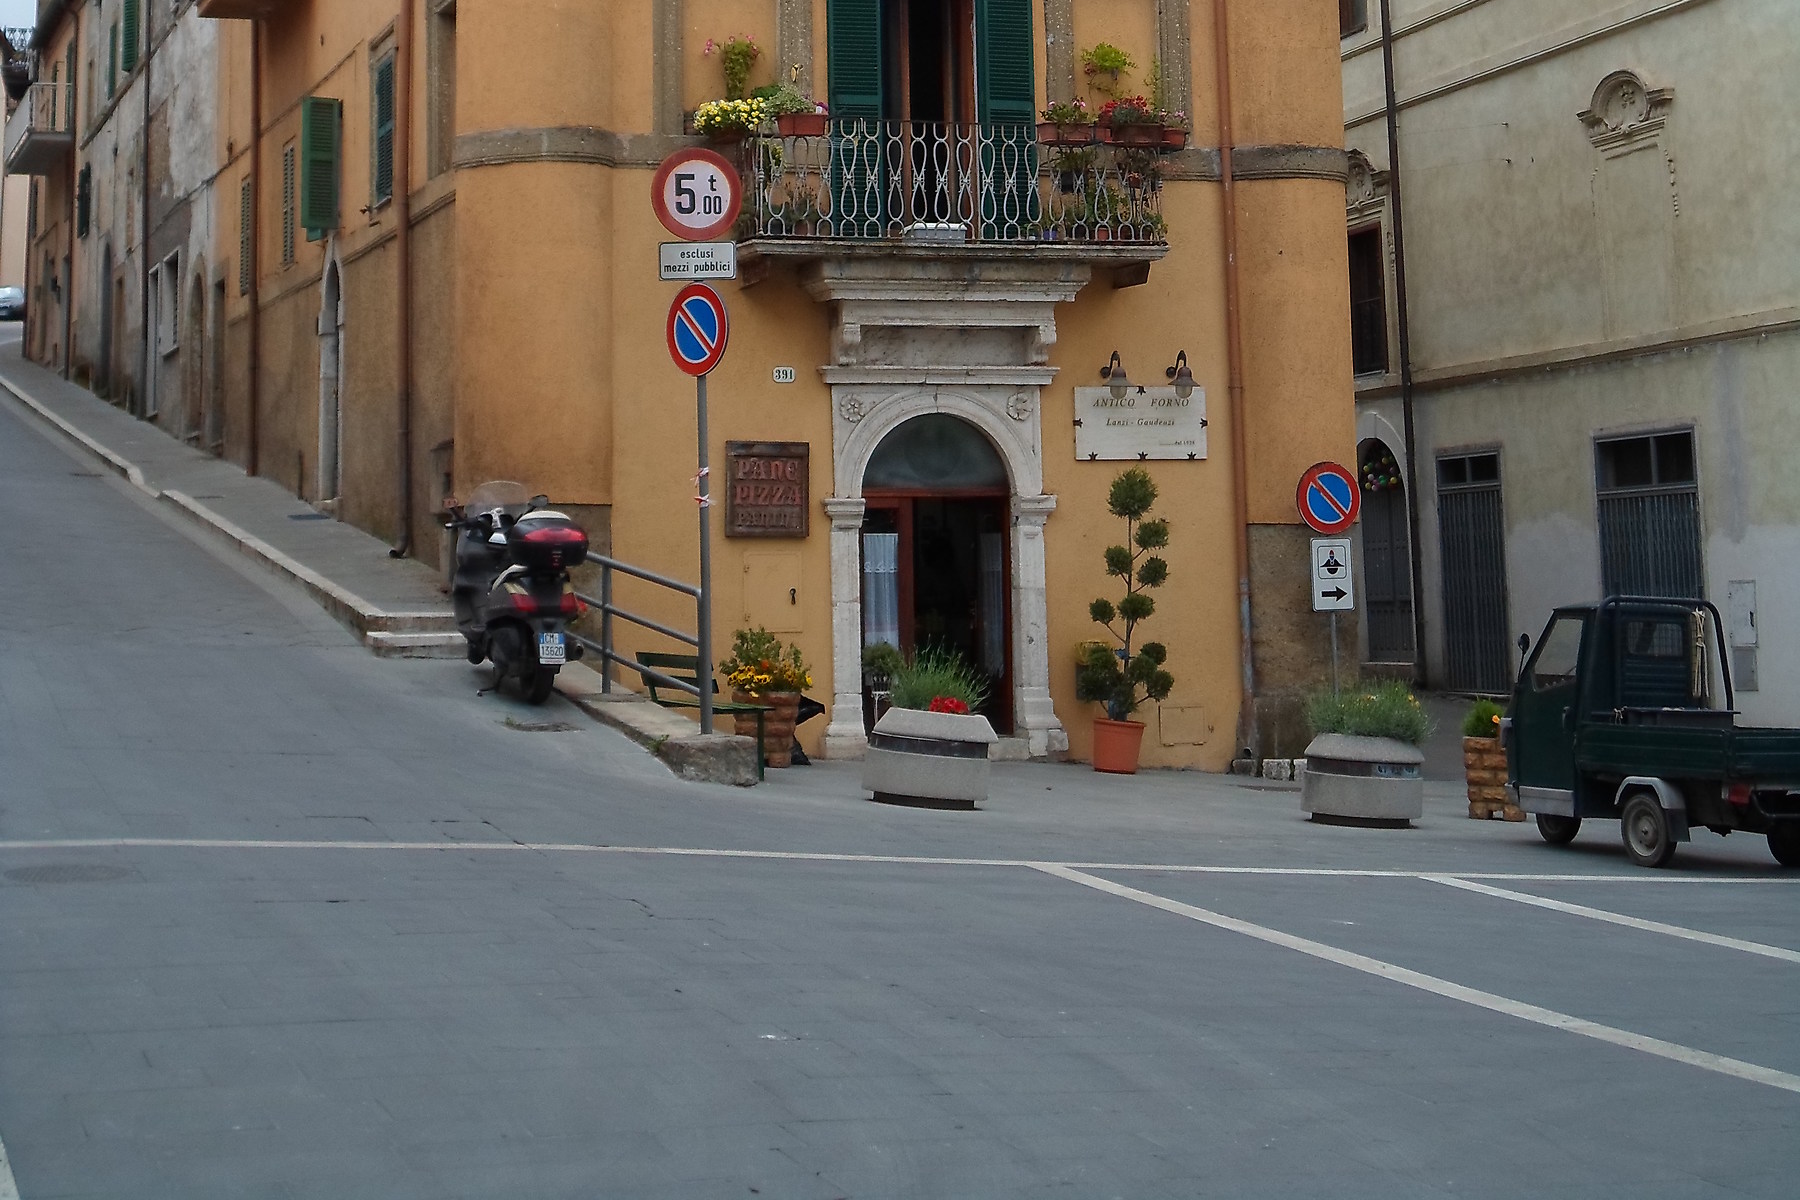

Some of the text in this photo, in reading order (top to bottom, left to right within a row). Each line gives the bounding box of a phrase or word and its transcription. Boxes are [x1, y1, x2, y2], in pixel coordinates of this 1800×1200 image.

[680, 248, 714, 259] esclusi
[664, 261, 730, 274] mezzi pubblici
[775, 369, 793, 380] 391
[1093, 398, 1189, 407] ANTICO FORNO
[1106, 418, 1129, 426] Lanzi
[734, 484, 802, 506] PIZZA
